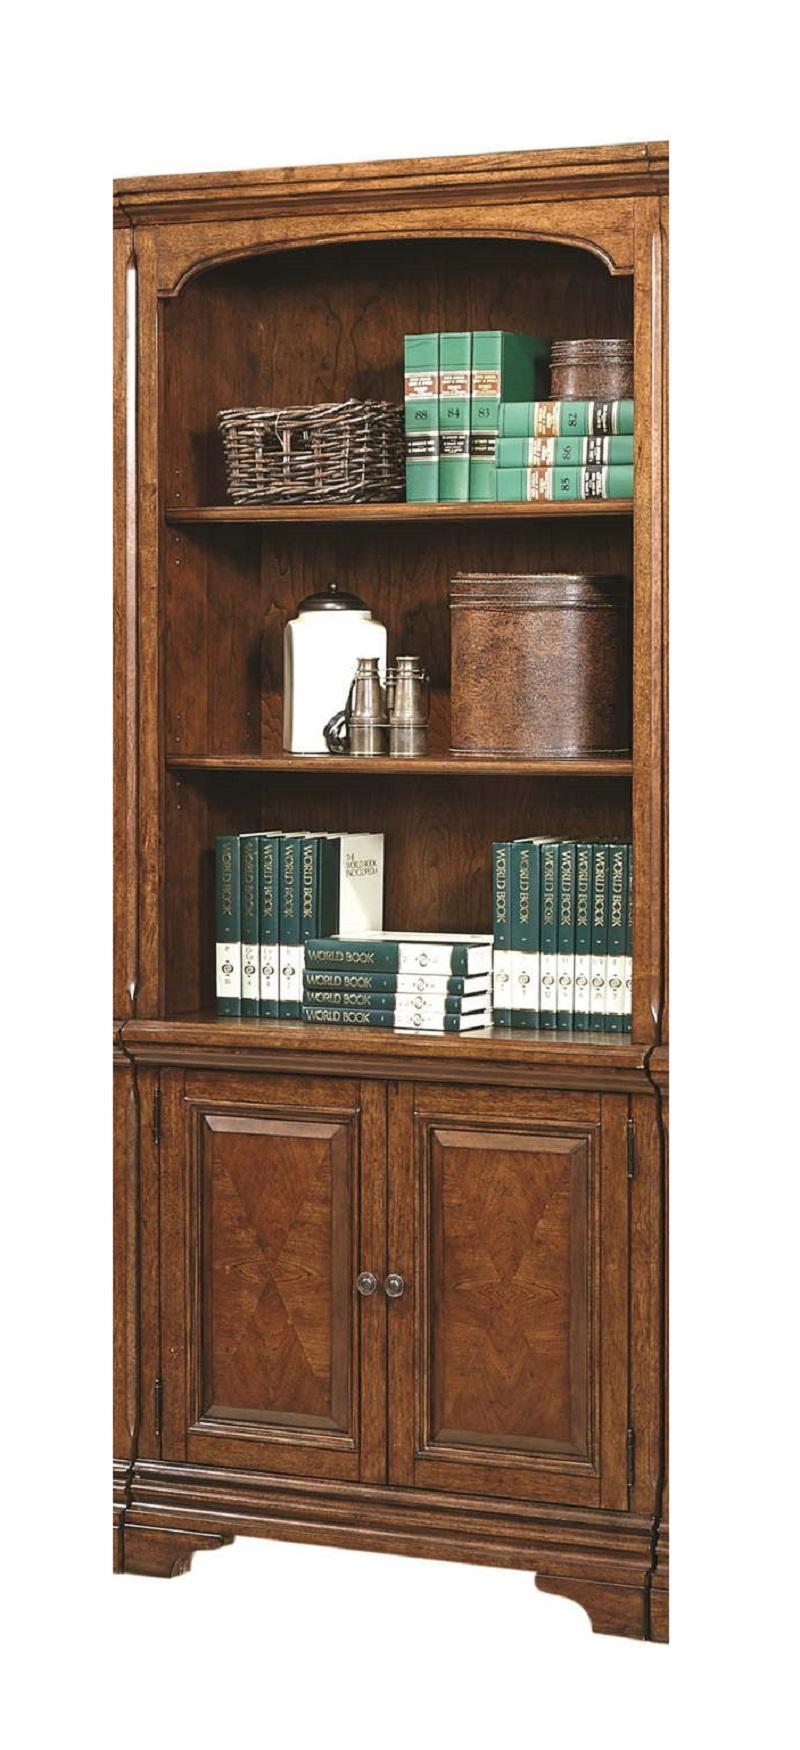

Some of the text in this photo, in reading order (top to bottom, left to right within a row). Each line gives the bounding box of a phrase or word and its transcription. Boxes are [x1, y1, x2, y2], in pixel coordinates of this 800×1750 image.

[447, 408, 461, 418] 84
[477, 408, 490, 418] 83
[568, 412, 577, 428] 82
[560, 477, 569, 491] 85
[222, 843, 232, 916] WORLD BOOK
[263, 844, 273, 917] WORLD BOOK
[283, 844, 293, 918] WORLD BOOK
[303, 845, 313, 919] WORLD BOOK
[495, 848, 506, 924] WORLD BOOK
[519, 849, 529, 924] WORLD BOOK
[543, 850, 554, 925] WORLD BOOK
[561, 851, 571, 926] WORLD BOOK
[578, 850, 588, 926] WORLD BOOK
[594, 851, 605, 927] WORLD BOOK
[611, 851, 623, 927] WORLD BOOK
[306, 974, 373, 988] WORLD BOOK
[307, 950, 344, 961] WORLD
[345, 951, 375, 964] BOOK
[305, 1009, 370, 1023] WORLD BOOK
[306, 991, 371, 1005] WORLD BOOK
